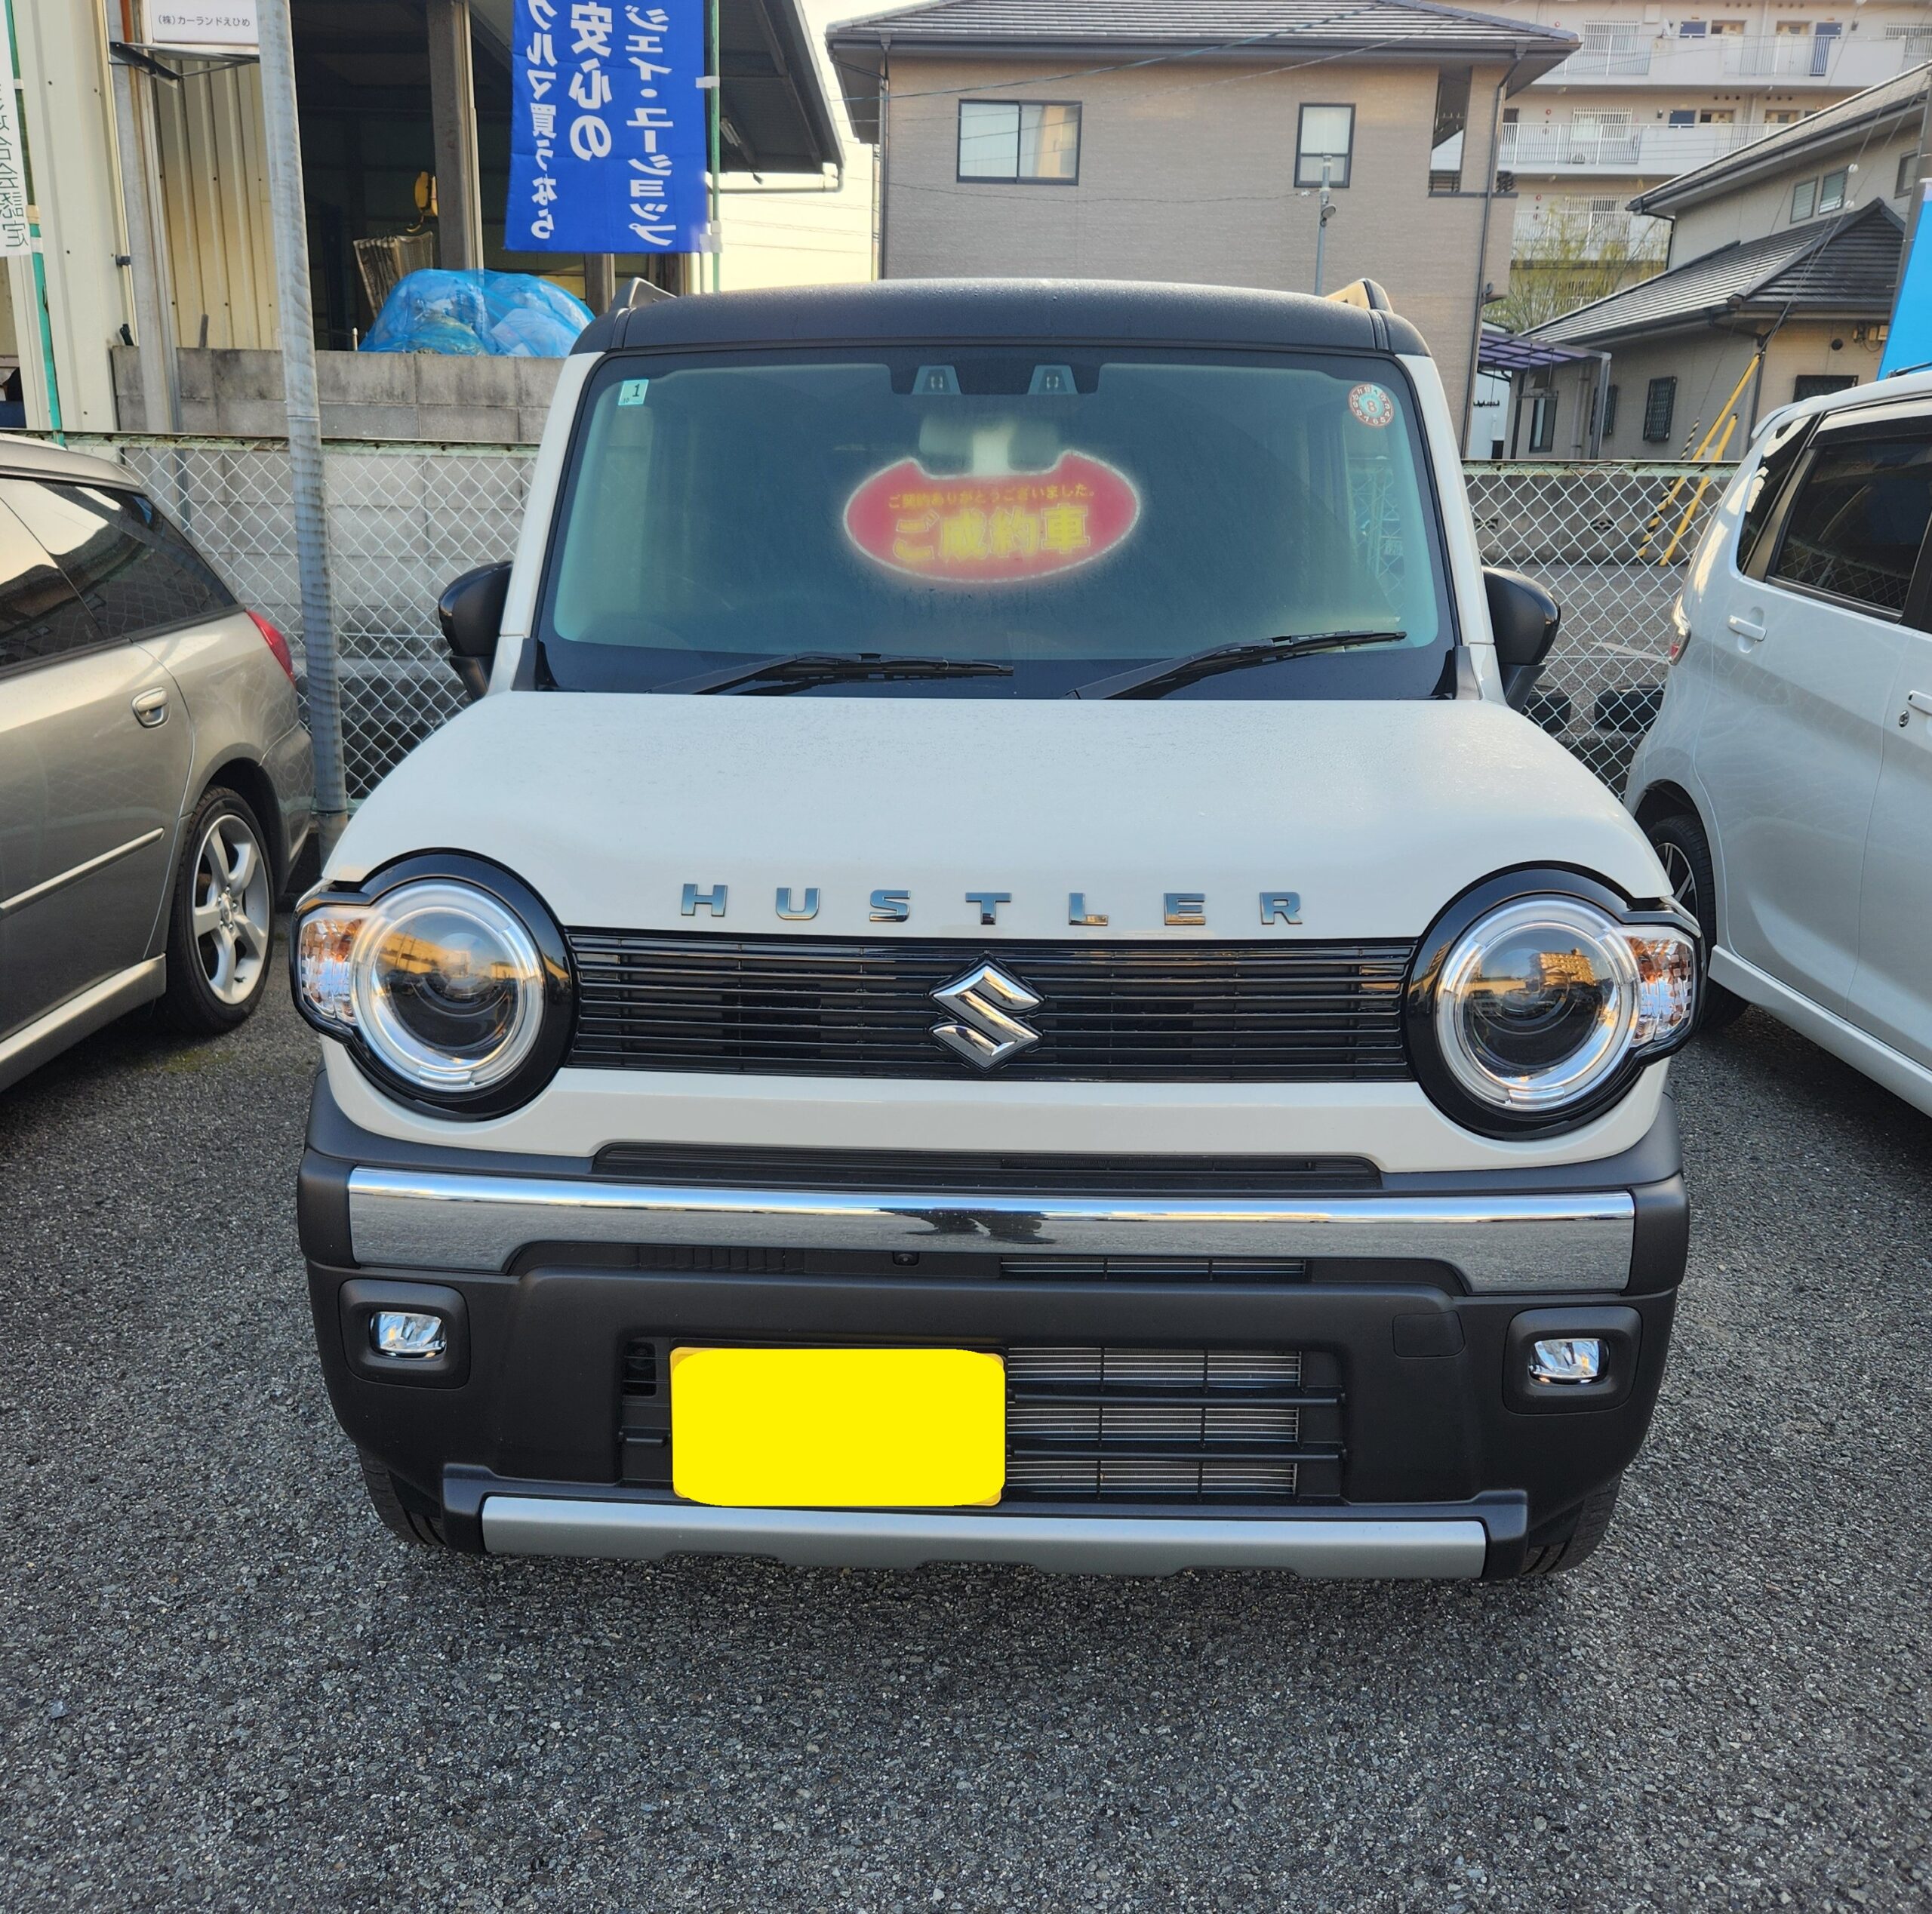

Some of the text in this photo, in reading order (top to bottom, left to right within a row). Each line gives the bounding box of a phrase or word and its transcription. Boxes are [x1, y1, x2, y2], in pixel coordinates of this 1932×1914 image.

[632, 383, 640, 397] 1
[893, 503, 1091, 563] ご成約車
[681, 883, 1303, 926] HUSTLER
